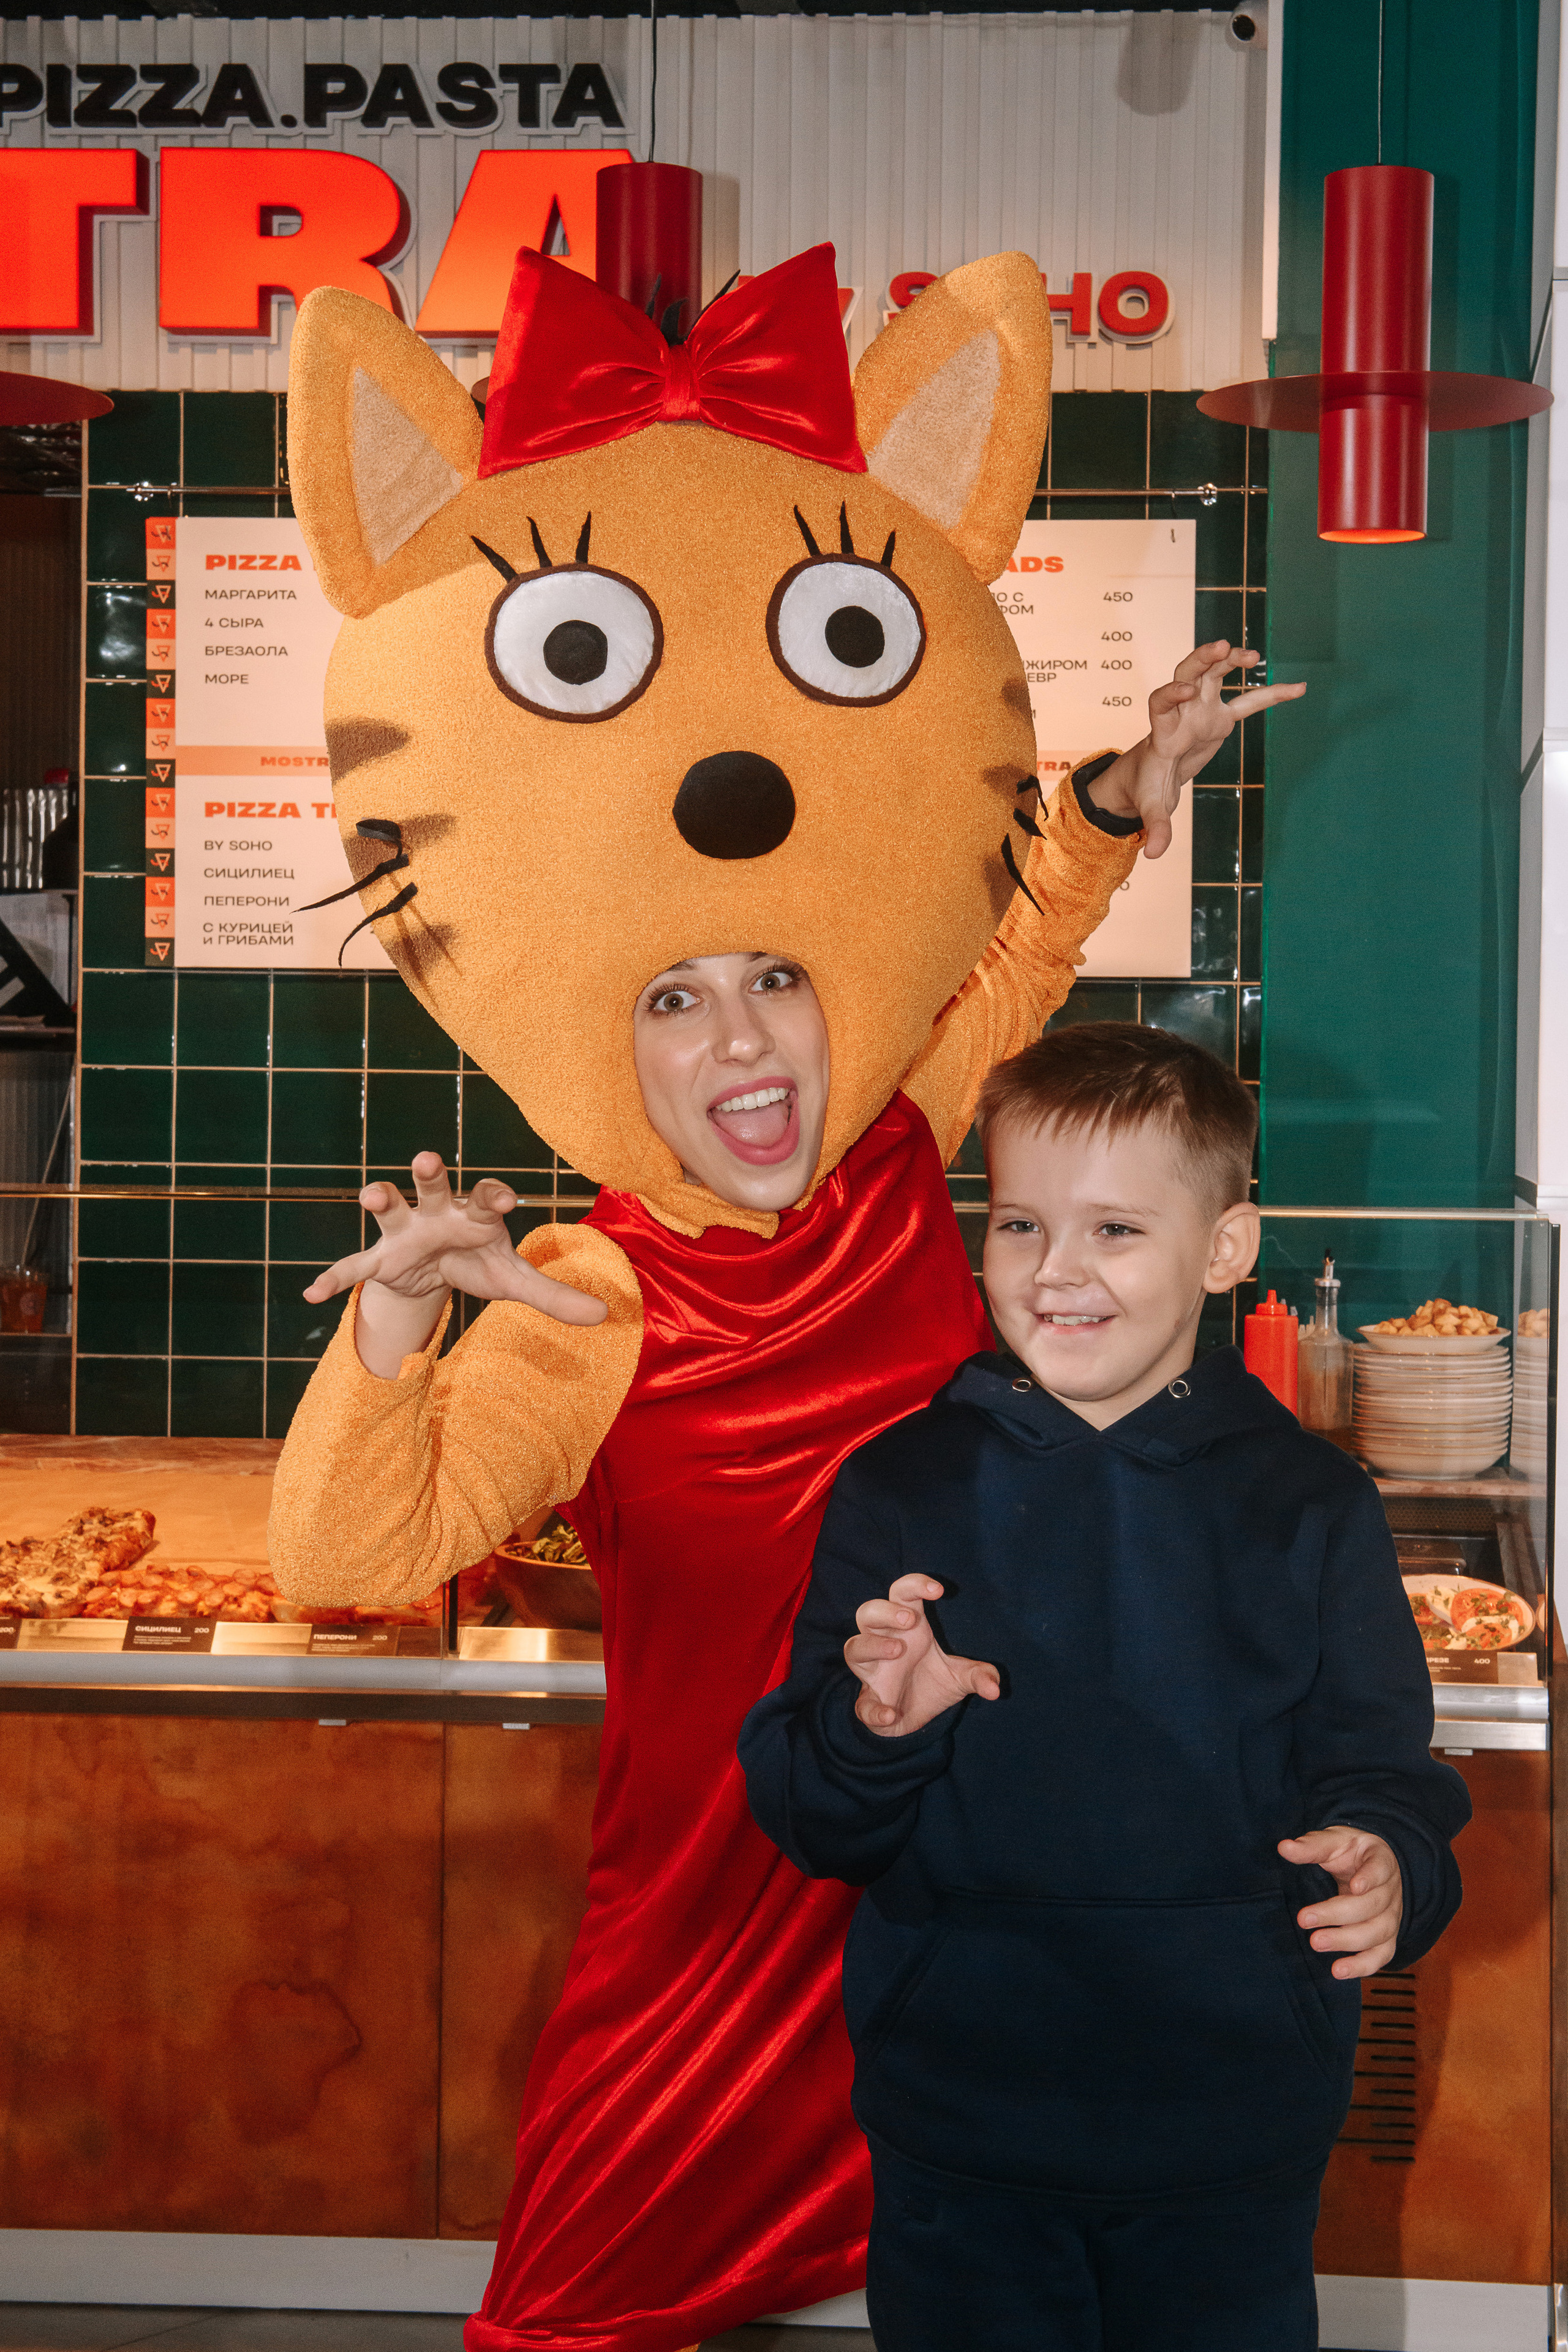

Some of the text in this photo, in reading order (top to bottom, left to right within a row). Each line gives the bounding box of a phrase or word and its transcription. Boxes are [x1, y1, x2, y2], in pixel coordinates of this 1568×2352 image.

[205, 554, 302, 571] PIZZA
[205, 589, 297, 600] МАРГАРИТА
[1103, 591, 1133, 602] 450
[205, 617, 264, 628] 4 СЫРА
[1101, 631, 1133, 642] 400
[205, 645, 288, 657] БРЕЗАОЛА
[1022, 660, 1088, 670] ЖИРОМ
[1101, 660, 1133, 671] 400
[205, 674, 249, 684] МОРЕ
[1102, 696, 1133, 707] 450
[205, 802, 301, 818] PIZZA
[204, 840, 273, 851] BY SOHO
[203, 867, 295, 880] СИЦИЛИЕЦ
[204, 895, 290, 907] ПЕПЕРОНИ
[203, 920, 293, 934] С КУРИЦЕЙ
[218, 934, 294, 945] ГРИБАМИ
